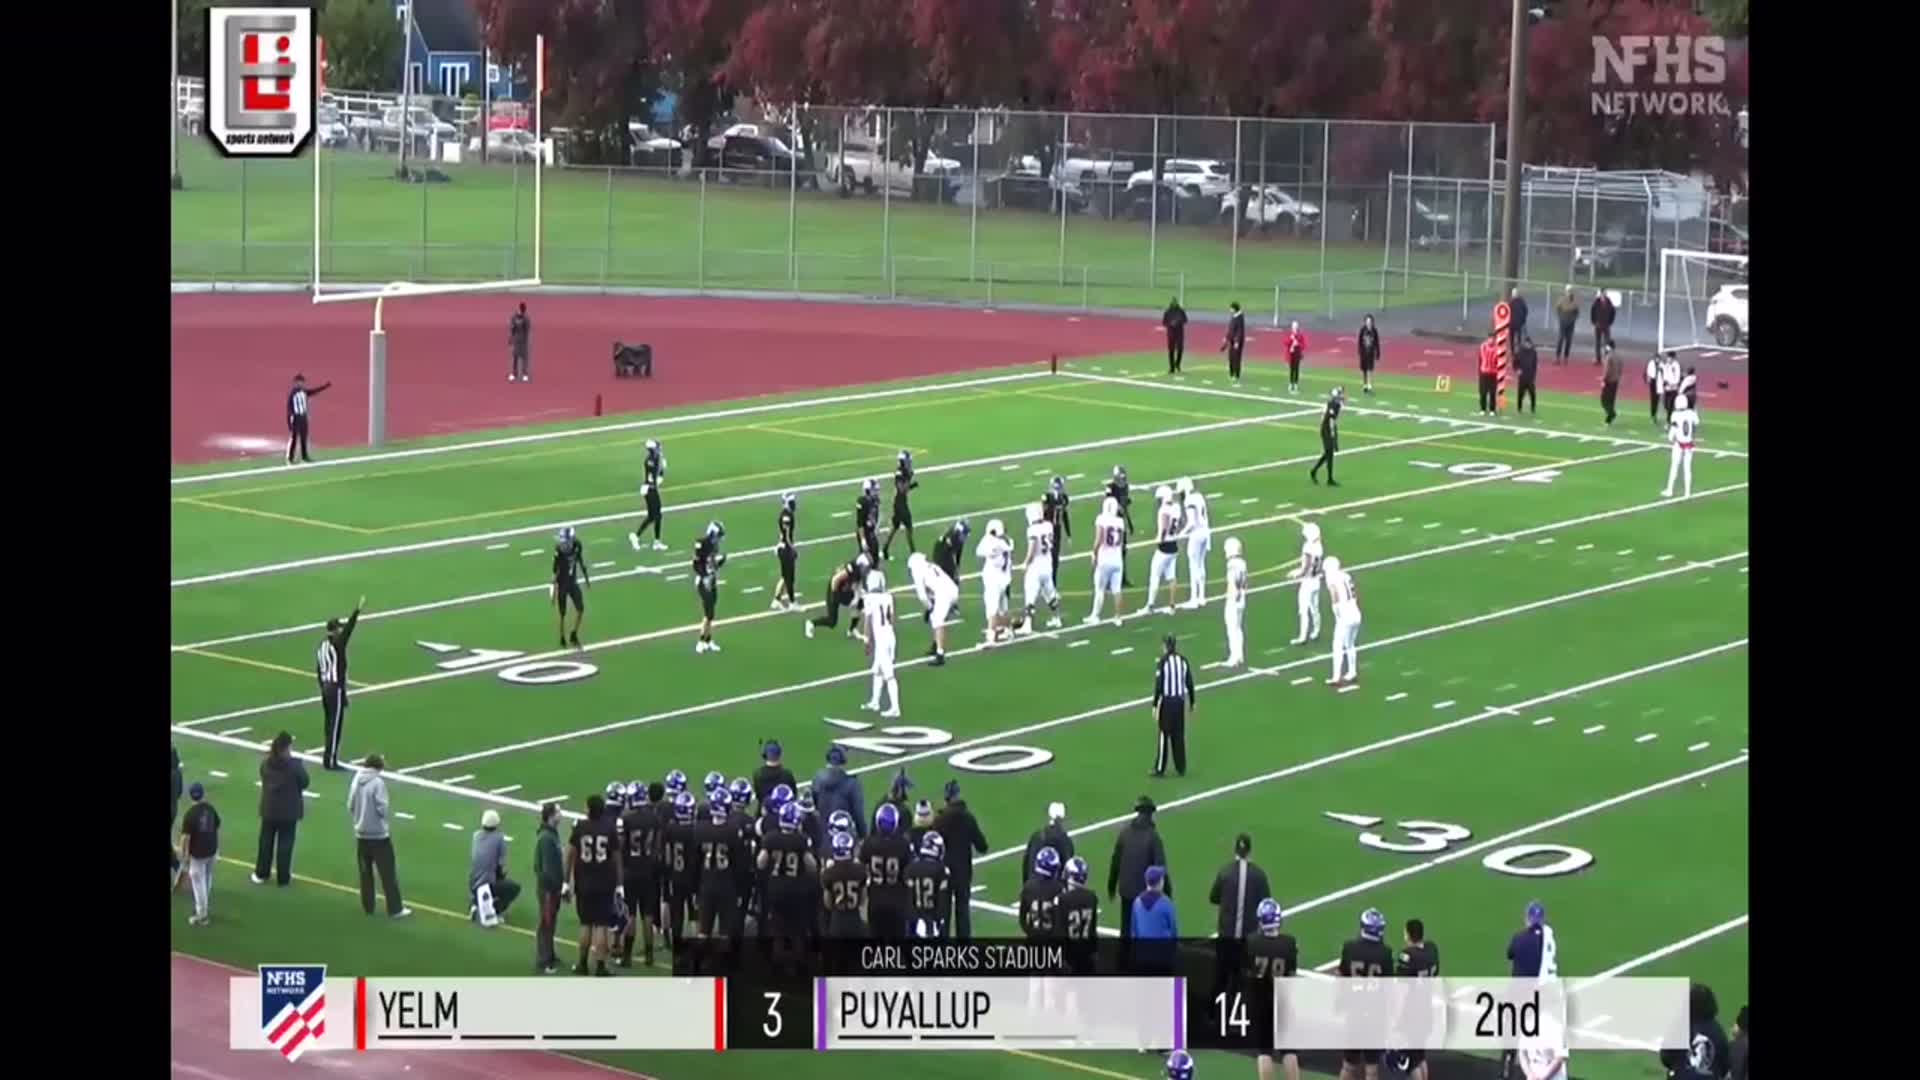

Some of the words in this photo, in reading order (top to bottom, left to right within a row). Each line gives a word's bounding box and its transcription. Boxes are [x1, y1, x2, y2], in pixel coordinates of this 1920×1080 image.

[436, 649, 598, 683] 10
[832, 726, 1053, 773] 20
[580, 834, 608, 863] 65
[701, 841, 729, 870] 76
[771, 848, 799, 877] 79
[1358, 820, 1594, 876] 30
[833, 880, 860, 911] 25
[915, 877, 934, 909] 12
[1068, 908, 1093, 939] 27
